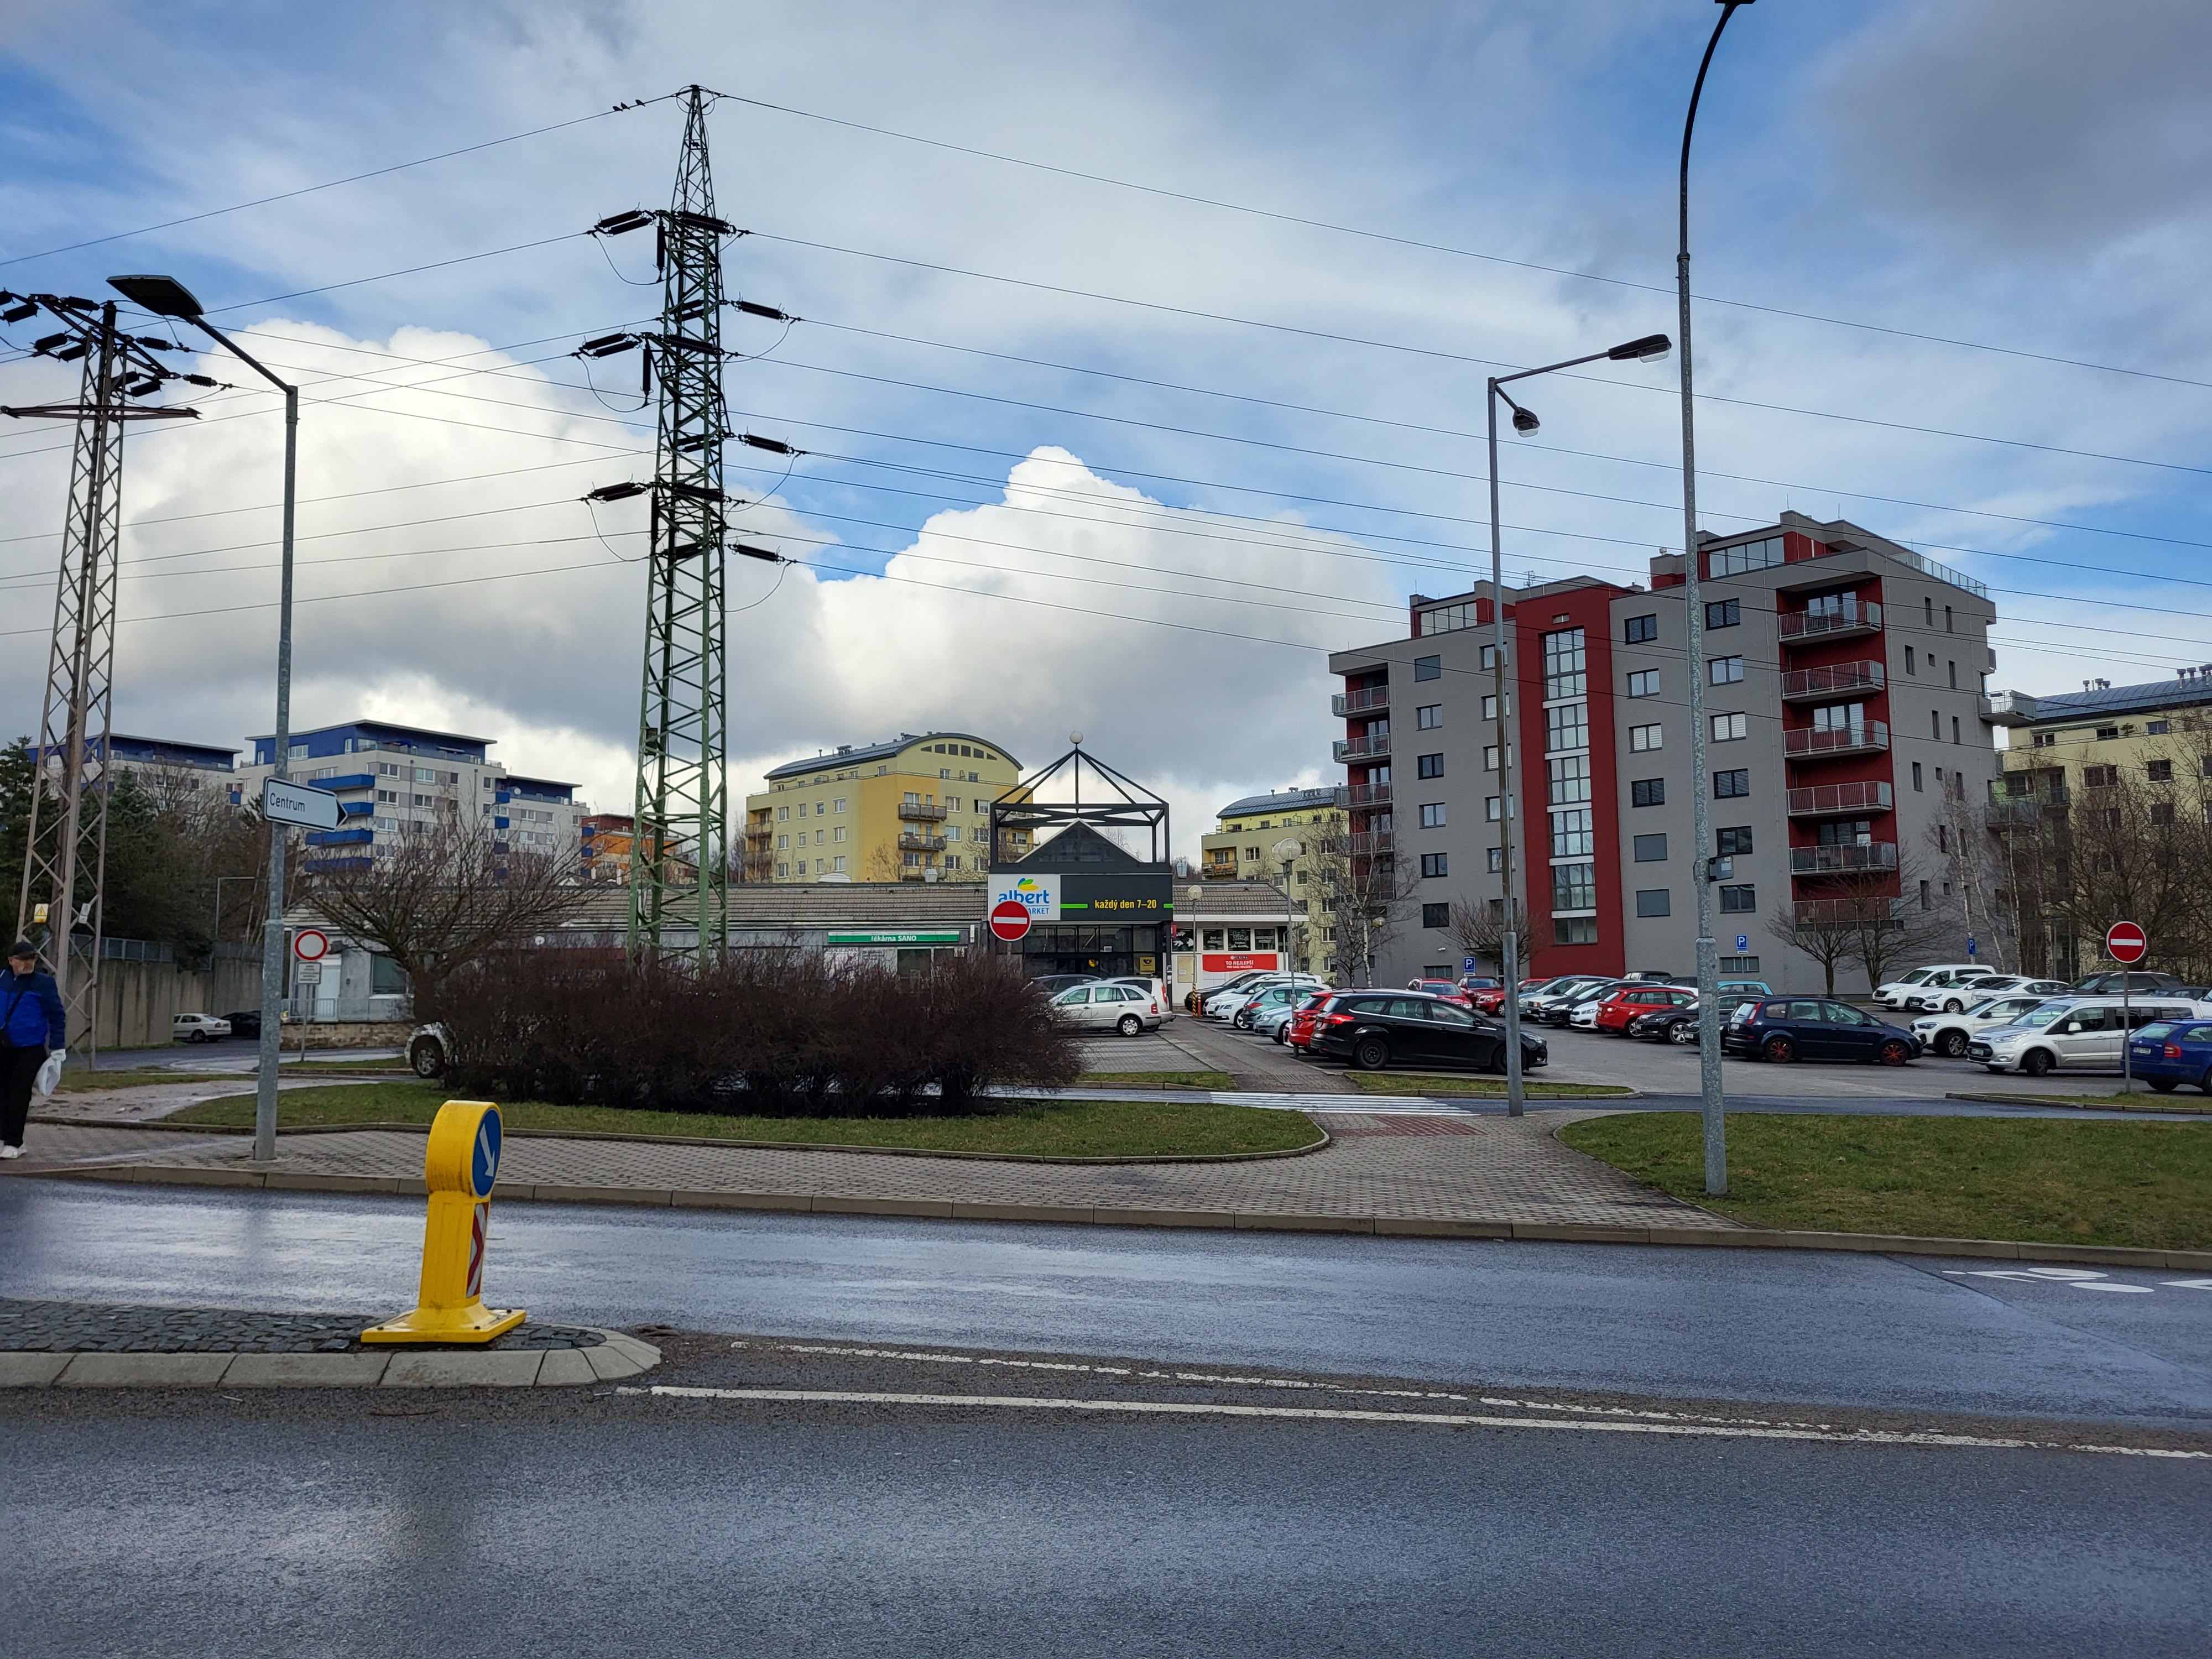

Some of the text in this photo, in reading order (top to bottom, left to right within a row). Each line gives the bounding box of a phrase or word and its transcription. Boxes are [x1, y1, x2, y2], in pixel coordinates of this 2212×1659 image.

[270, 792, 305, 812] Centrum
[998, 890, 1050, 904] albert
[1094, 899, 1118, 910] každý
[1120, 899, 1135, 909] den
[1738, 936, 1745, 946] P
[1969, 940, 1974, 950] P
[1466, 959, 1473, 968] P
